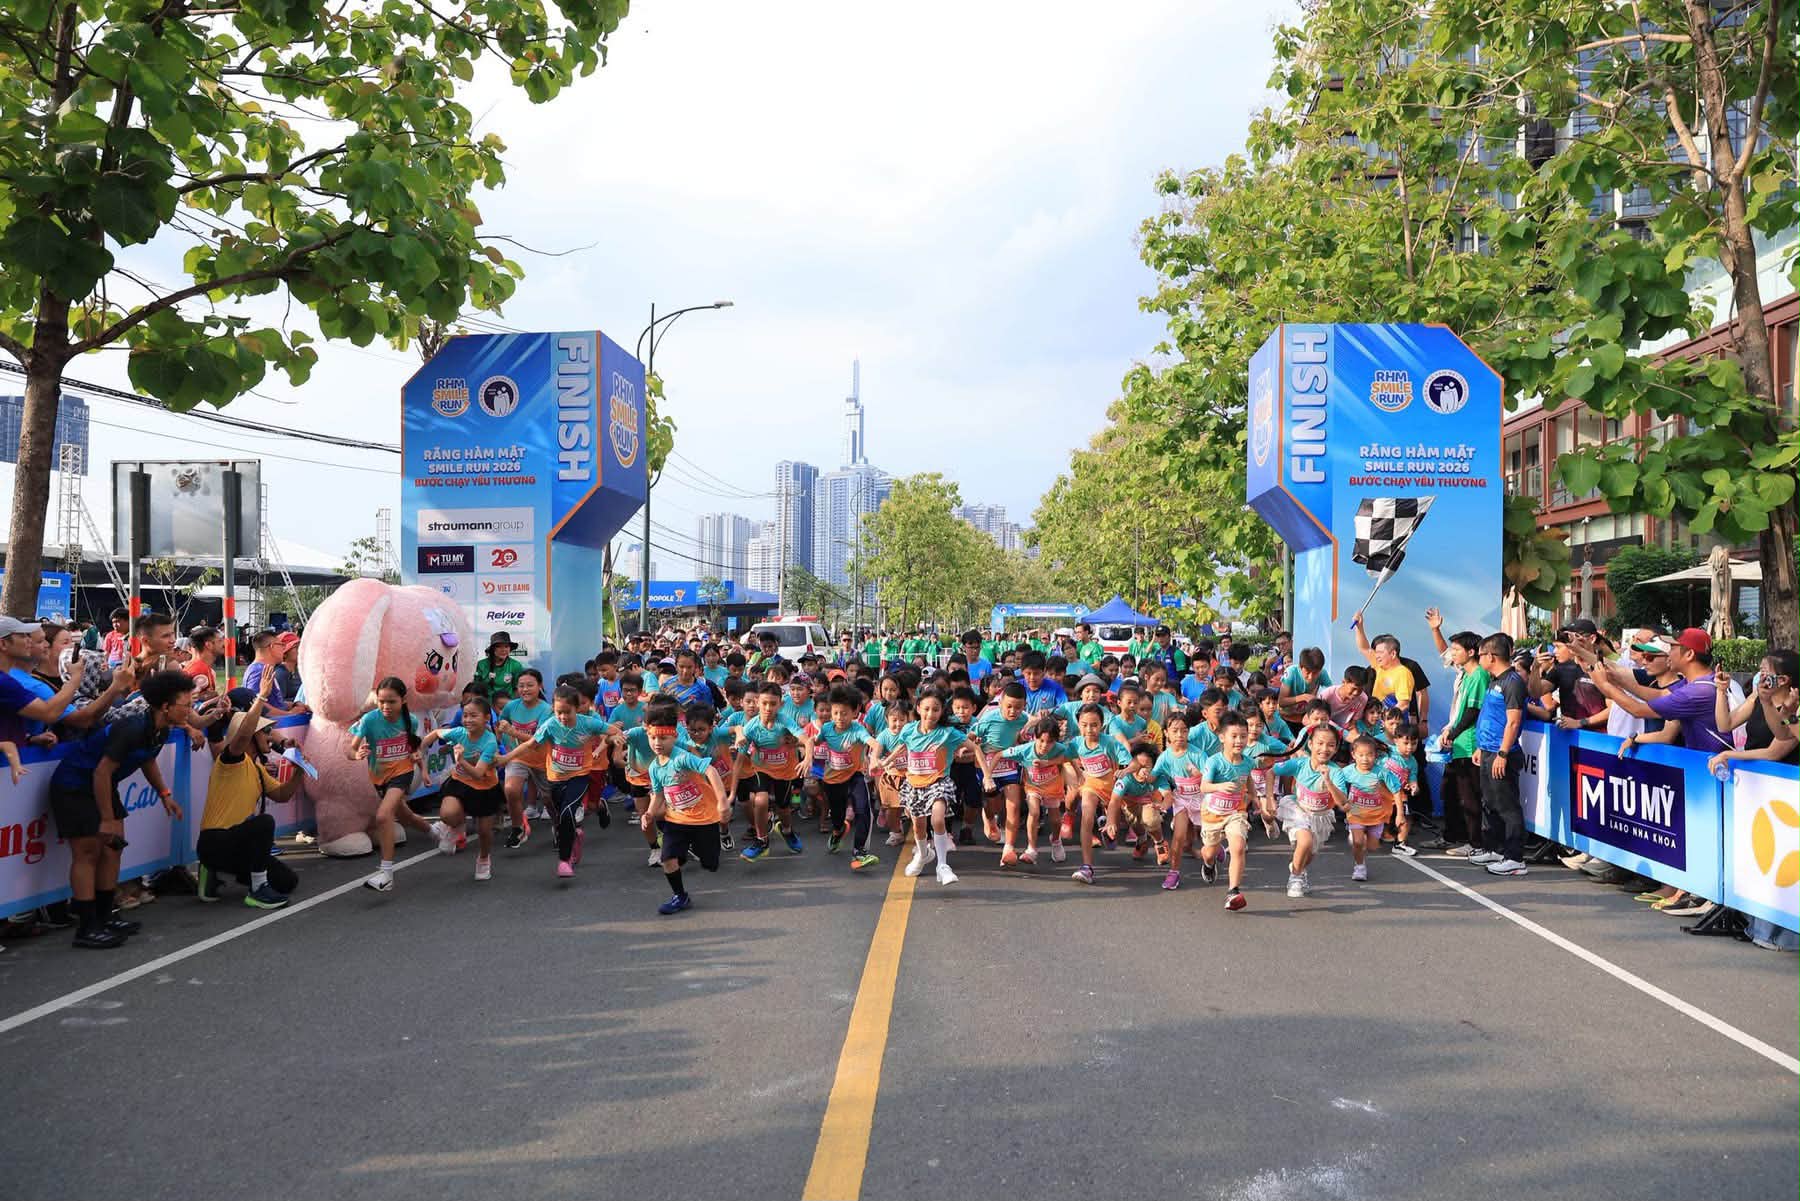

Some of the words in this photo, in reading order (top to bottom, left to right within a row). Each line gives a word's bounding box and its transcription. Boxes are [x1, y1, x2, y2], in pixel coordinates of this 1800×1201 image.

[437, 379, 465, 389] RHM
[1375, 372, 1407, 382] RHM
[434, 389, 469, 400] SMILE
[613, 372, 635, 409] RHM
[1372, 382, 1411, 393] SMILE
[440, 400, 463, 409] RUN
[1379, 393, 1405, 403] RUN
[558, 337, 590, 481] FINISH
[611, 396, 638, 433] SMILE
[1291, 332, 1327, 483] FINISH
[464, 445, 495, 460] HÀM
[1360, 443, 1401, 459] RĂNG
[1405, 443, 1440, 459] HÀM
[428, 463, 463, 474] SMILE
[466, 463, 491, 473] RUN
[493, 462, 521, 473] 2026
[1365, 462, 1404, 473] SMILE
[1407, 462, 1436, 473] RUN
[1438, 462, 1470, 474] 2026
[1608, 776, 1636, 816] TÚ
[1641, 784, 1675, 827] MỸ
[0, 814, 48, 864] ng
[1609, 820, 1630, 833] LABO
[1632, 827, 1649, 841] NHA
[1652, 833, 1677, 849] KHOA
